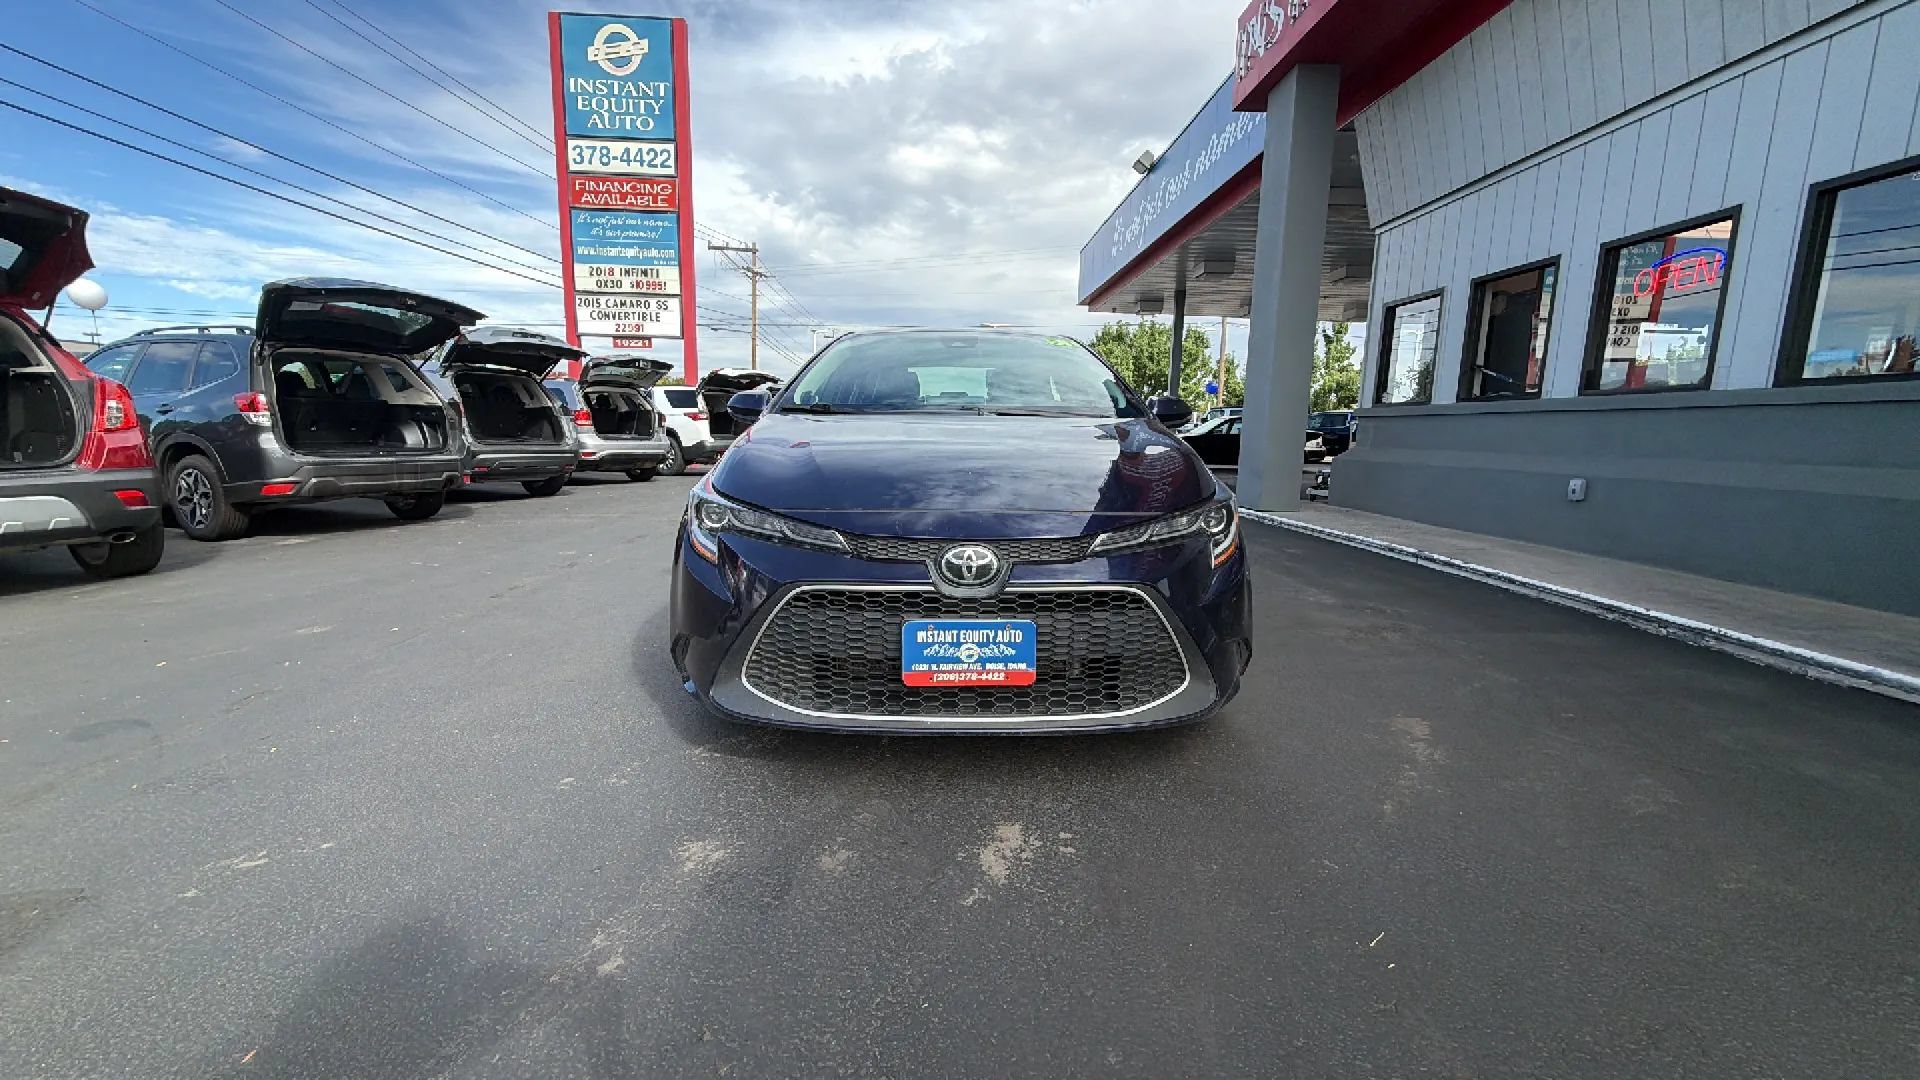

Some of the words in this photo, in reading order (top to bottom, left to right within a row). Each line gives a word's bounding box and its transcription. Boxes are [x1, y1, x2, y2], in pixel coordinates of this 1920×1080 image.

[569, 77, 670, 97] INSTANT
[578, 95, 665, 115] EQUITY
[587, 113, 655, 131] AUTO
[571, 144, 673, 169] 378-4422
[575, 179, 673, 195] FINANCING
[580, 192, 669, 207] AVAILABLE
[577, 243, 675, 259] www.instantequityauto.com
[588, 266, 615, 277] 2018
[1633, 253, 1722, 298] OPEN
[577, 297, 601, 308] 2015
[605, 298, 650, 310] CAMARO
[655, 299, 669, 310] SS
[590, 310, 661, 322] CONVERTIBLE
[916, 629, 959, 643] INSTANT
[959, 629, 995, 643] EQUITY
[996, 629, 1023, 643] AUTO
